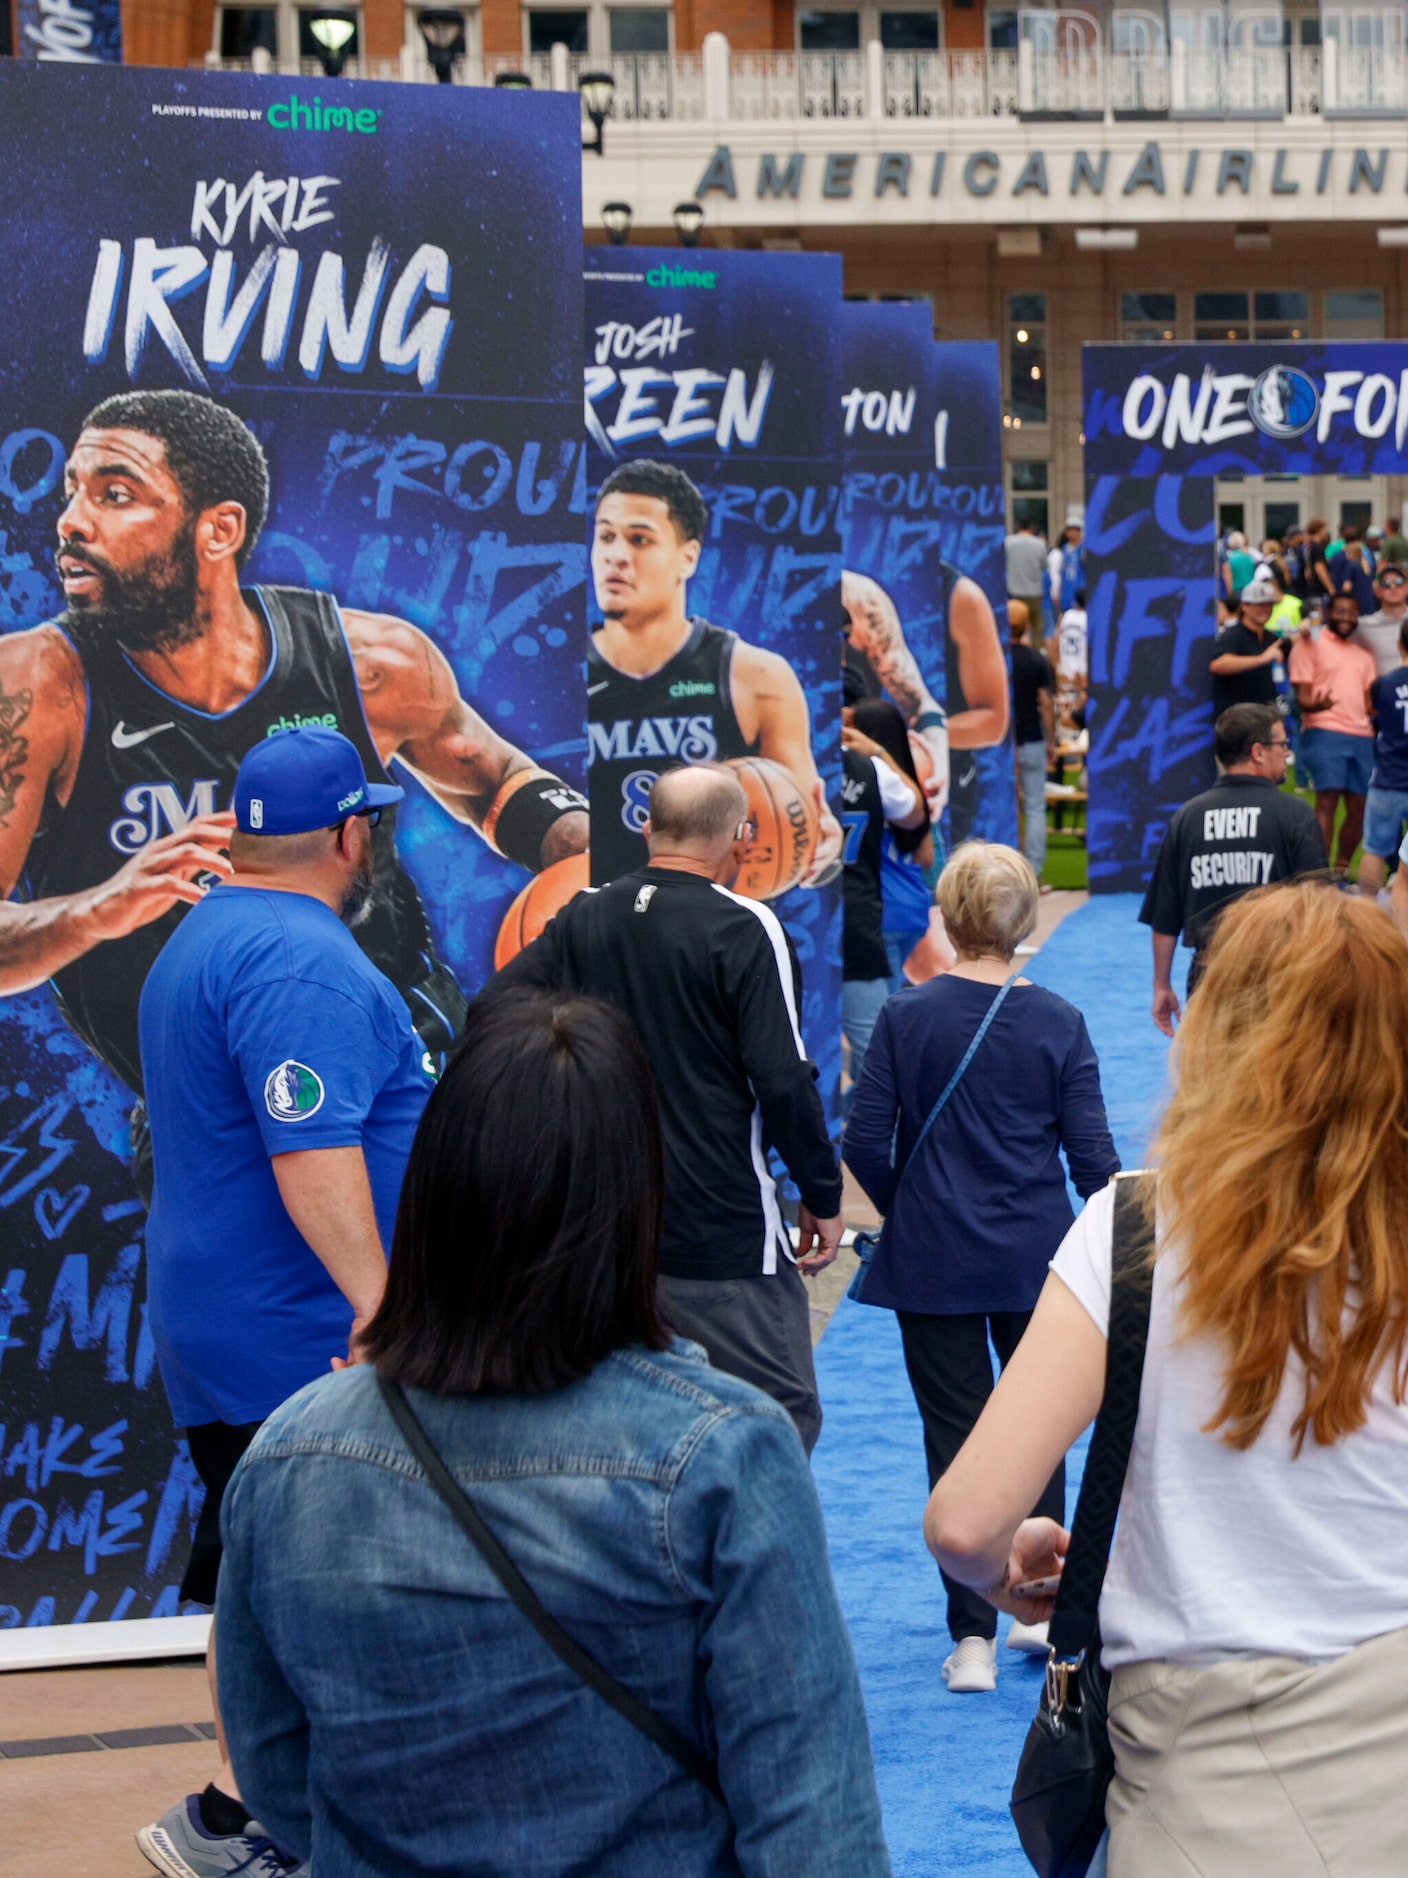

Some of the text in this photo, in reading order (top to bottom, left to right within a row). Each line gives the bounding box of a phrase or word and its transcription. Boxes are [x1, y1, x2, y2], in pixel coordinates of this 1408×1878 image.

[152, 103, 262, 121] PLAYOFFS PRESENTED BY
[267, 94, 378, 135] chime
[190, 169, 343, 247] KYRIE
[645, 263, 718, 290] chime
[82, 234, 454, 395] IRVING
[595, 312, 697, 366] JOSH
[841, 384, 918, 437] TON
[1121, 362, 1259, 451] ONE
[669, 680, 716, 698] chime
[588, 714, 719, 767] MAVS
[1203, 806, 1262, 842] EVENT
[1190, 850, 1275, 890] SECURITY
